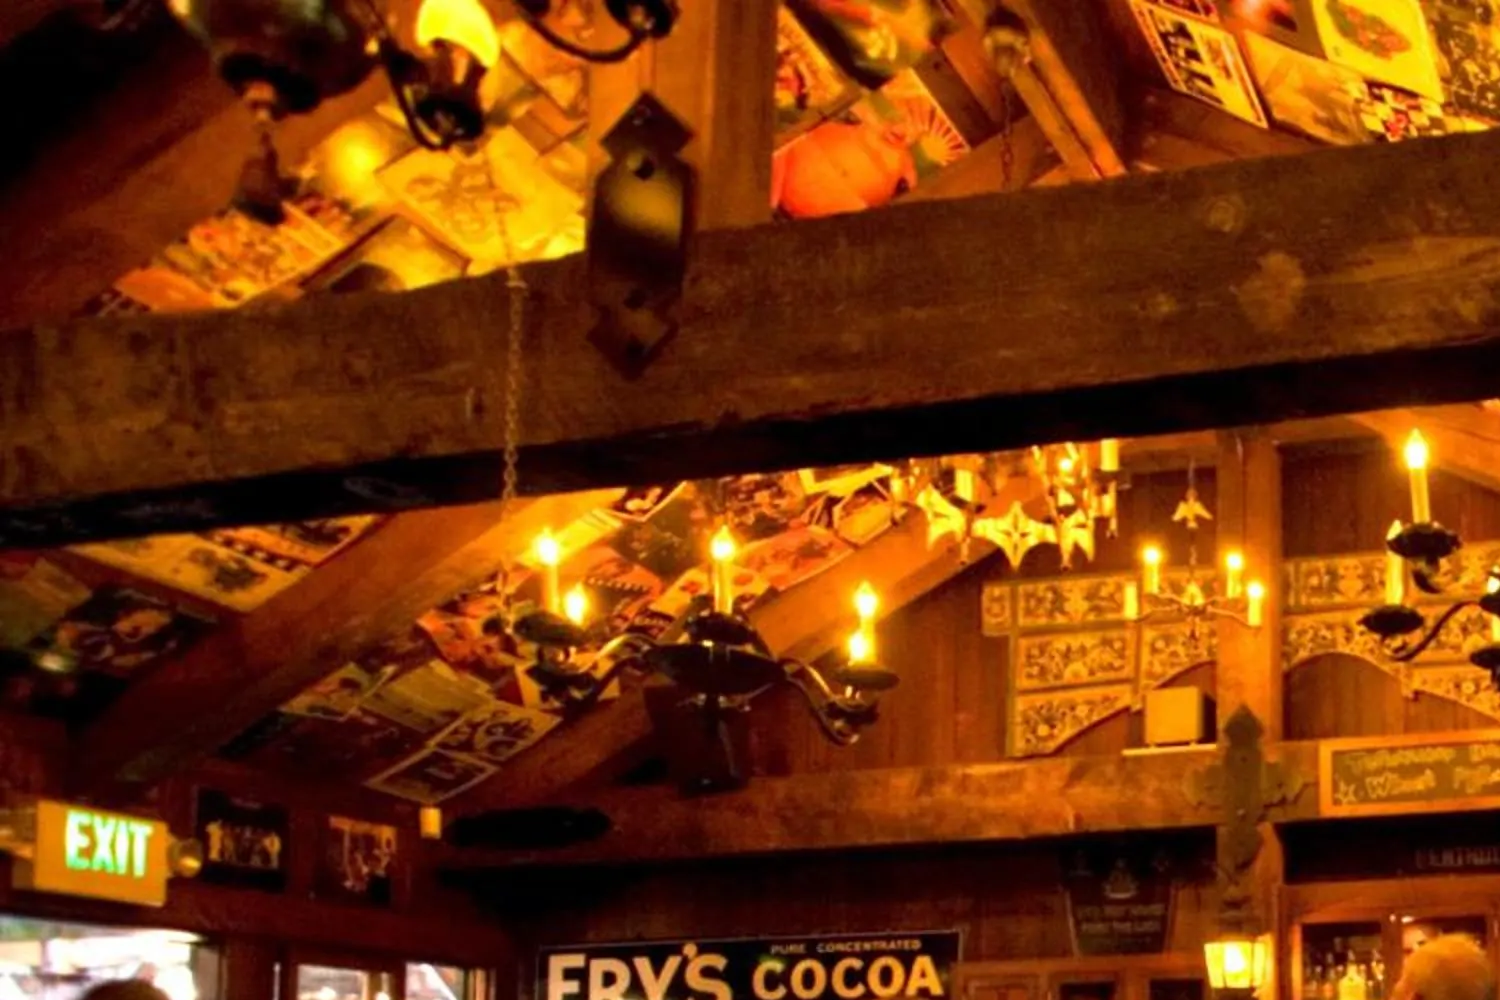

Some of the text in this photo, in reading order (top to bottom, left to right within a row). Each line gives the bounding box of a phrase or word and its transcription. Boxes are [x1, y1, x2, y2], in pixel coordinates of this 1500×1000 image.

[66, 809, 153, 878] EXIT
[771, 939, 922, 955] PURE CONCENTRATED
[752, 955, 943, 1000] COCOA
